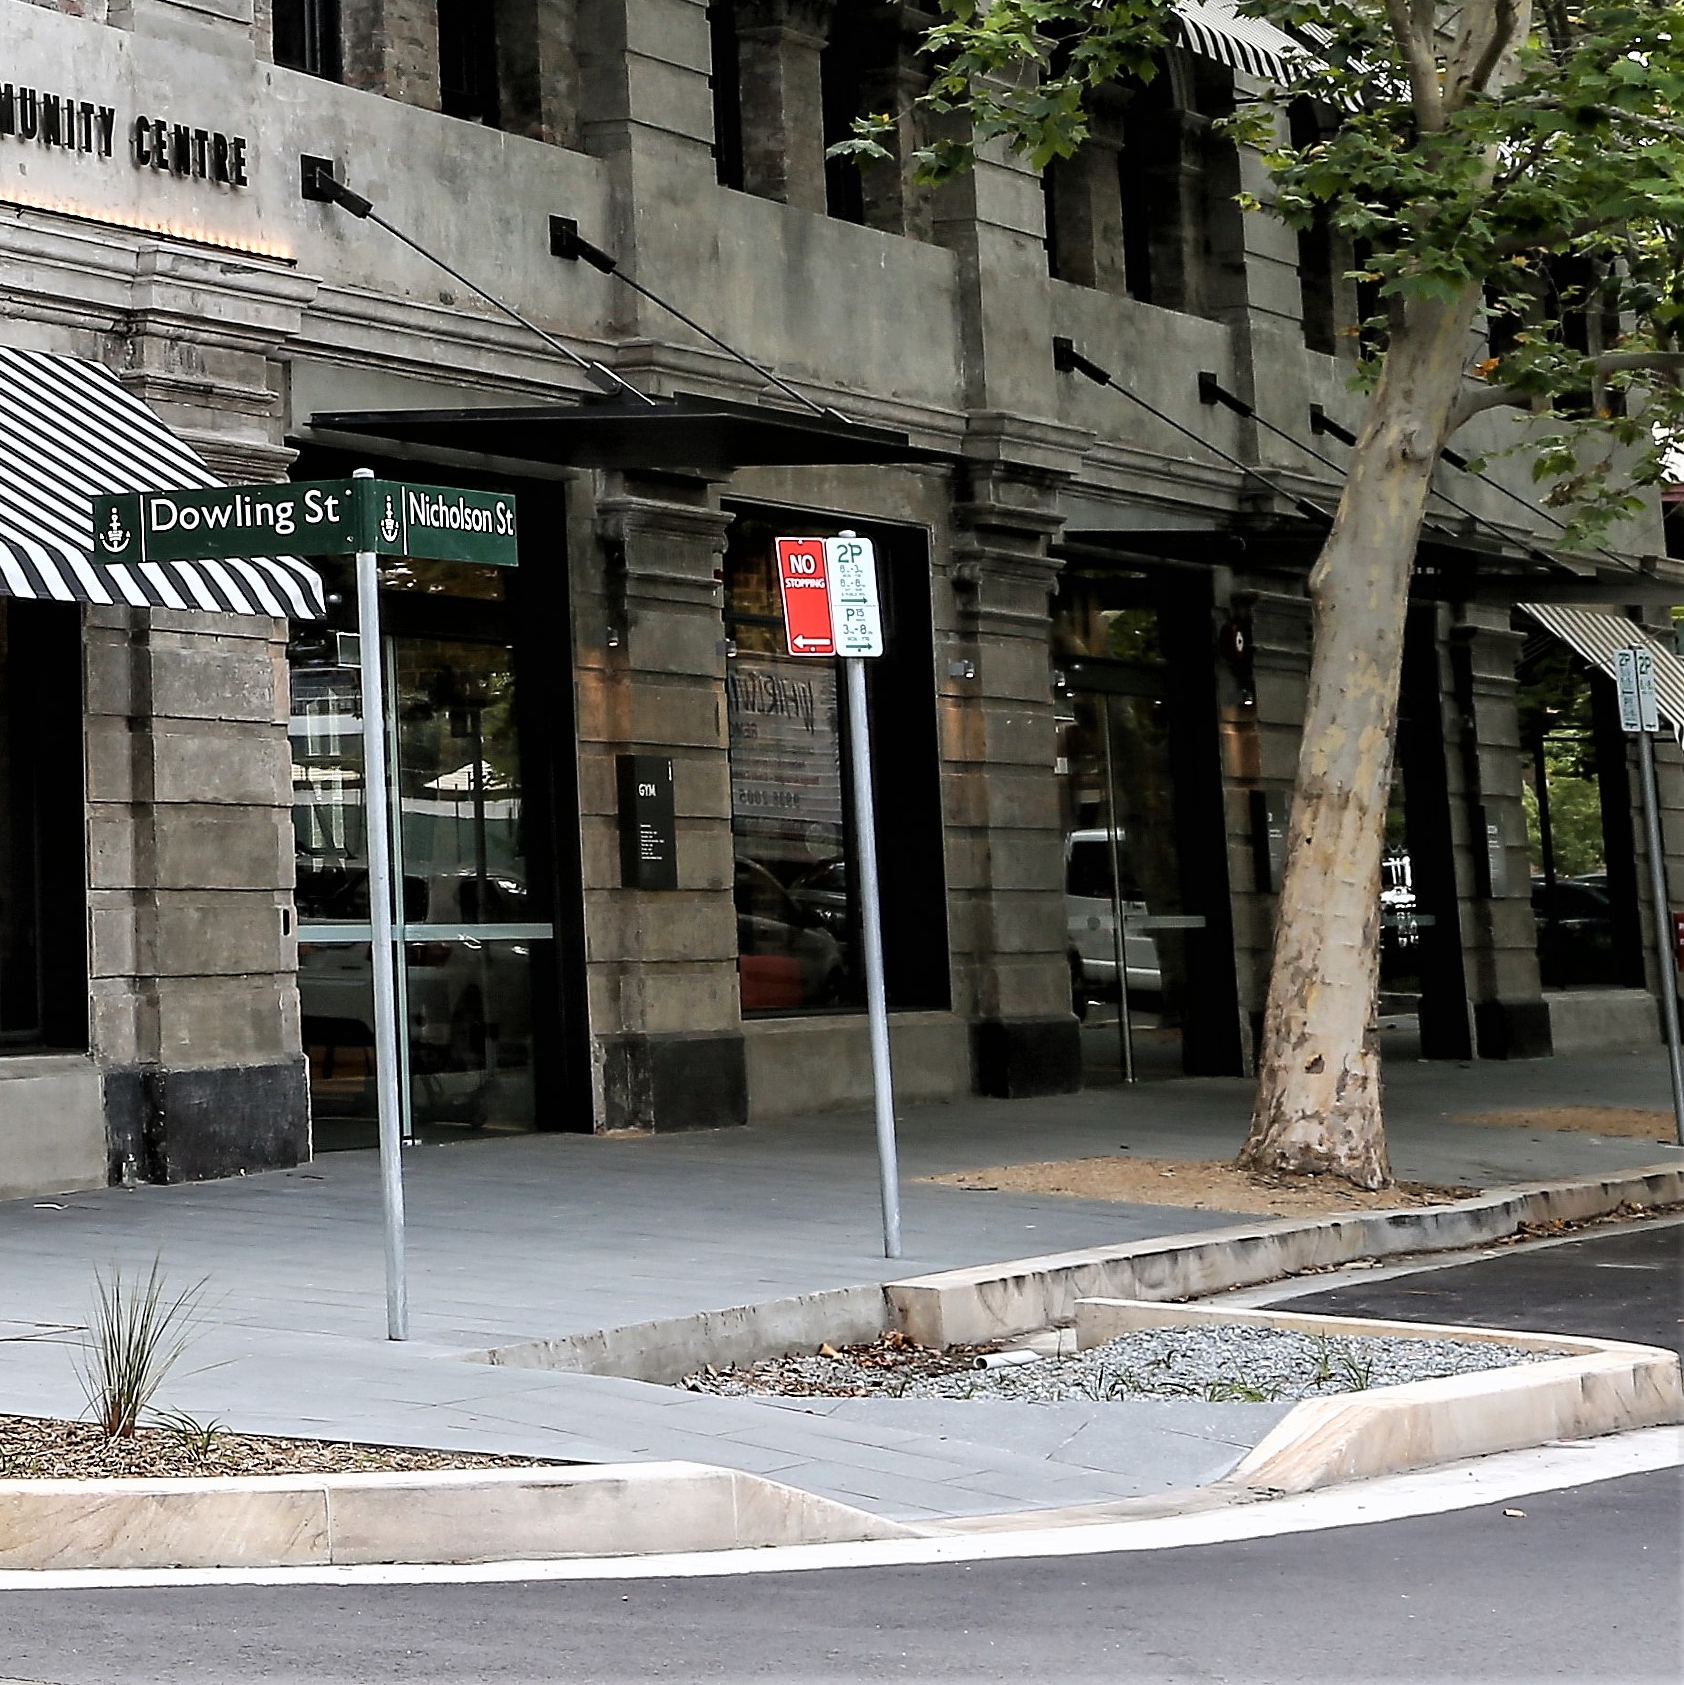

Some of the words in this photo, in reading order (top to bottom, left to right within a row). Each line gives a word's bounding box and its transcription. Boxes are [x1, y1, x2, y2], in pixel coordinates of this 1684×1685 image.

[135, 114, 249, 188] CENTRE
[149, 495, 295, 535] Dowling
[303, 489, 340, 524] St
[408, 490, 494, 533] Nicholson
[495, 500, 515, 536] St
[836, 543, 863, 563] 2P
[789, 554, 816, 575] NO
[785, 578, 826, 589] STOPPING
[638, 783, 657, 797] GYM
